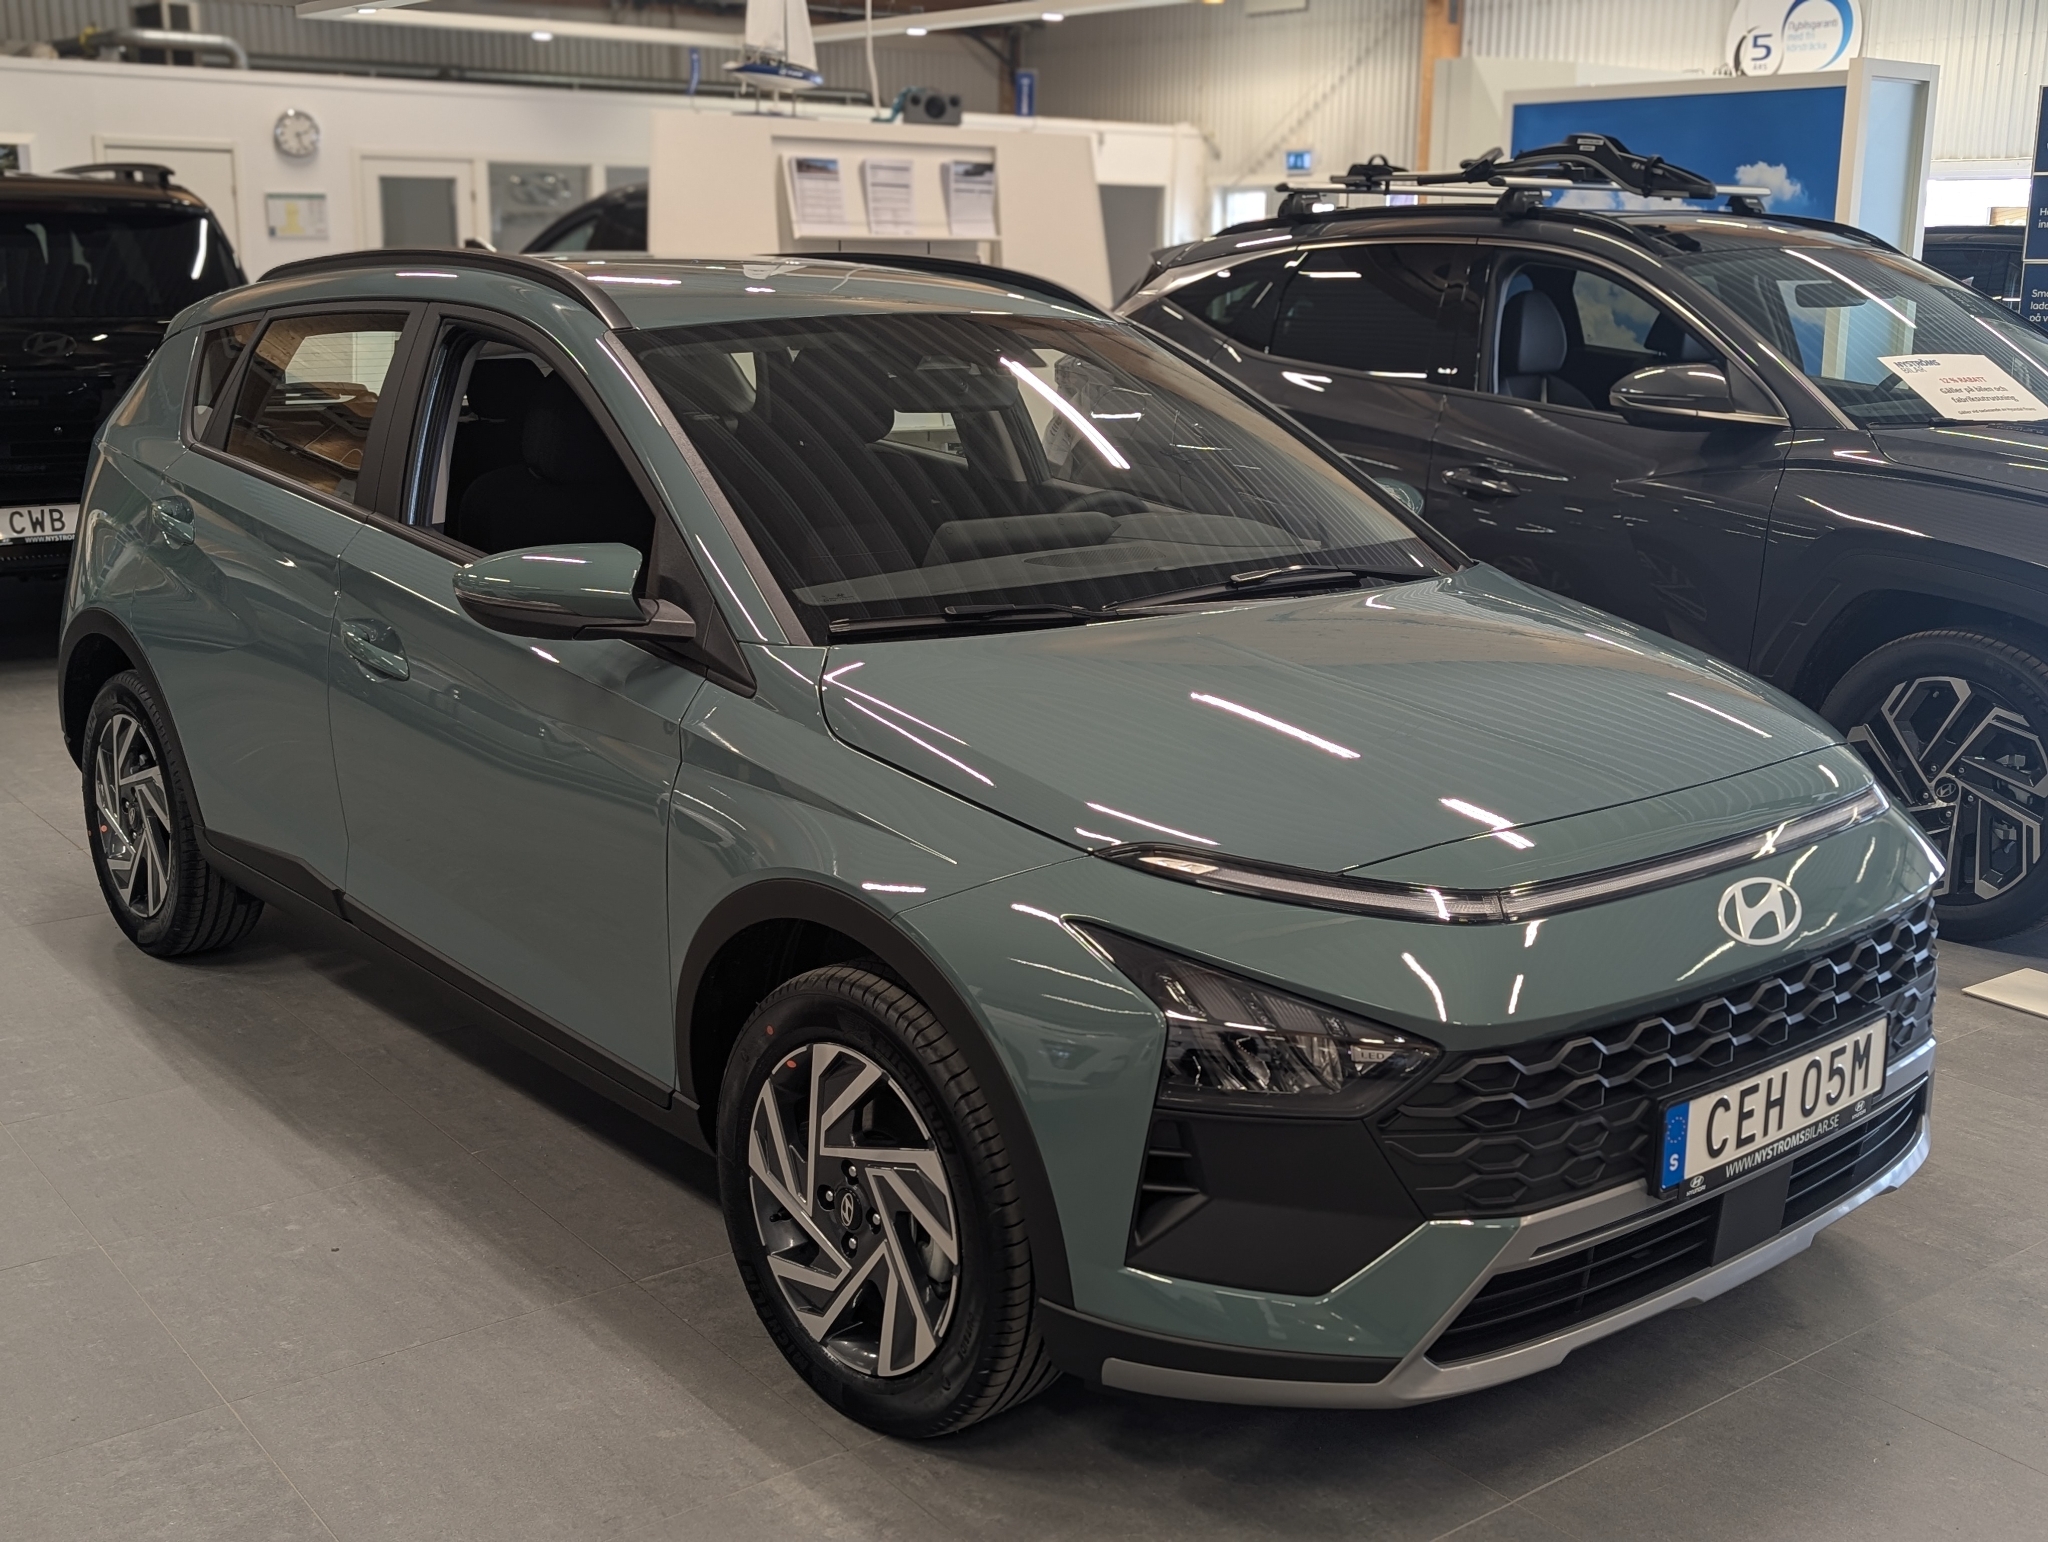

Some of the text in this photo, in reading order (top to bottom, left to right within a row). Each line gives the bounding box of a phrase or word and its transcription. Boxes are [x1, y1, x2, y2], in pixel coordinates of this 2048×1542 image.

[1751, 33, 1773, 62] 5
[1958, 376, 1987, 384] RABATT
[9, 508, 66, 535] CWB
[1361, 1052, 1385, 1060] LED
[1706, 1070, 1788, 1158] CEH
[1725, 1113, 1841, 1178] WWW.NYSTROMSBILAR.SE
[1669, 1153, 1680, 1172] S
